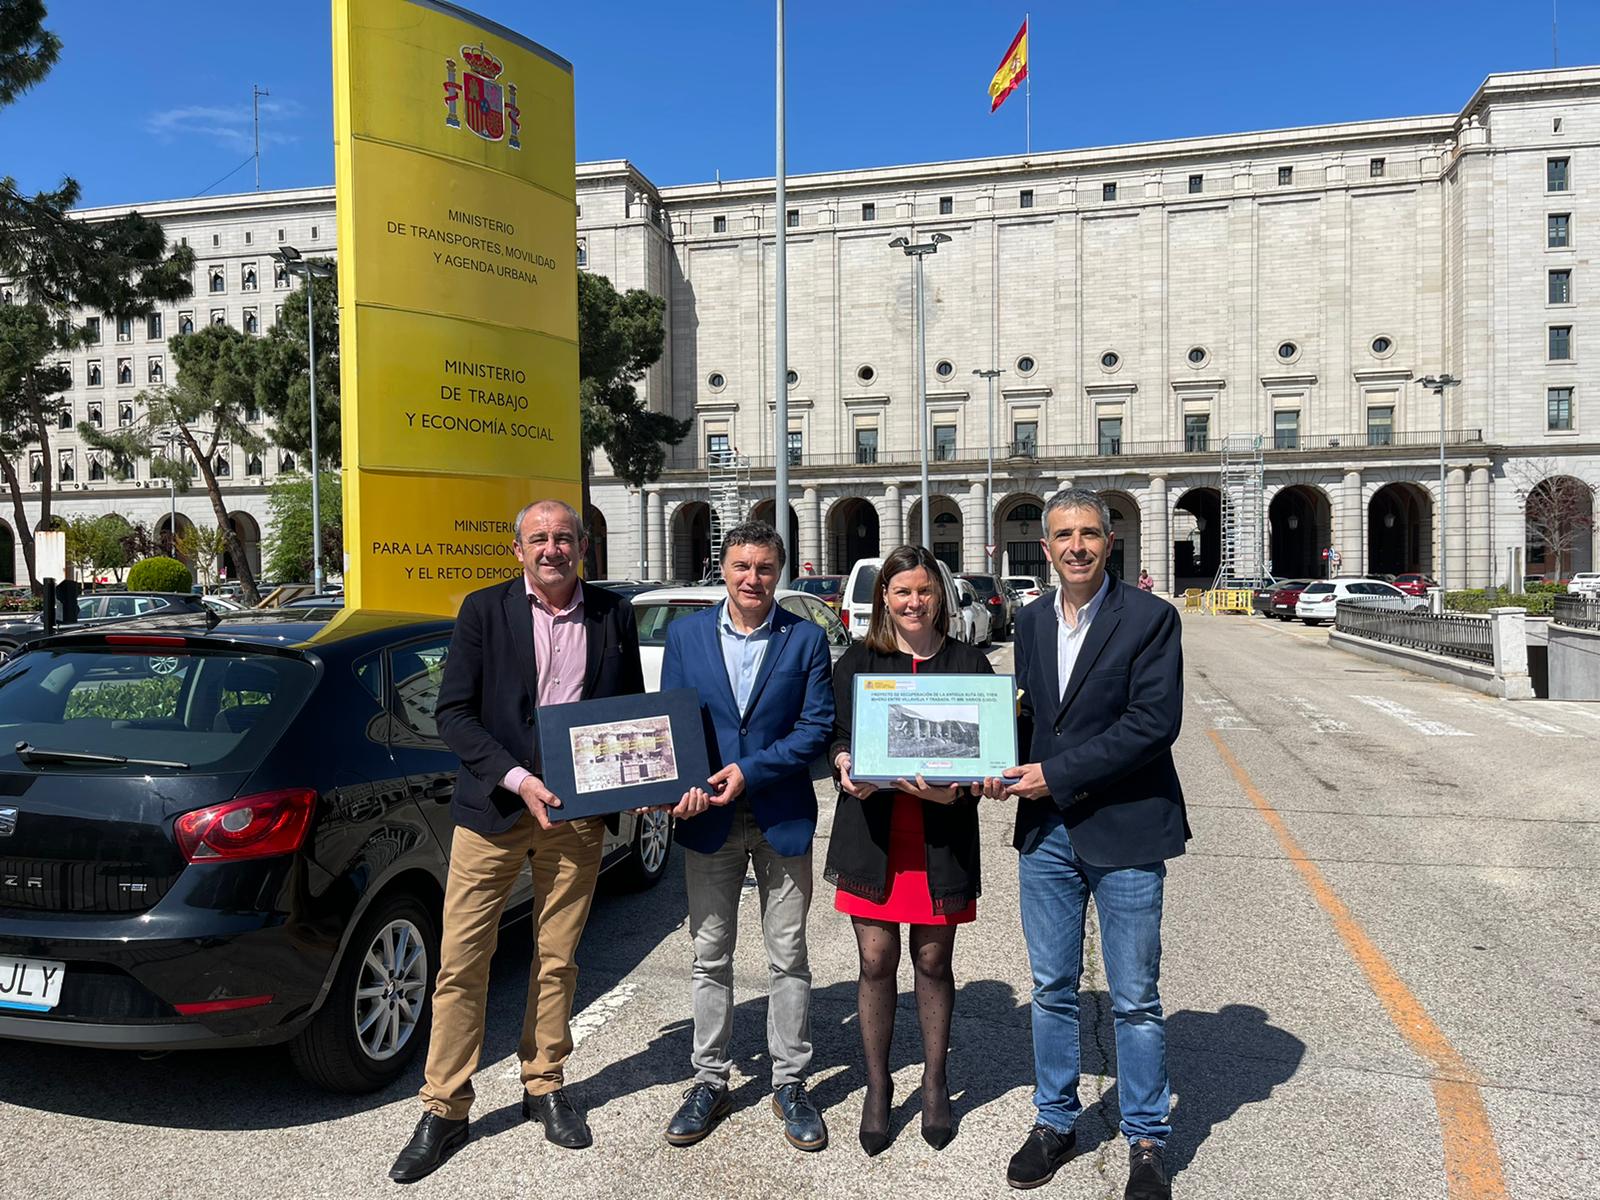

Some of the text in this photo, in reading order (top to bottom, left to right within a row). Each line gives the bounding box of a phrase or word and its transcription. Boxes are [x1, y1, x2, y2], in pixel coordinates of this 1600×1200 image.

[448, 209, 515, 236] MINISTERIO
[387, 221, 556, 270] DE TRANSPORTES, MOVILIDAD
[433, 252, 538, 285] Y AGENDA URBANA
[445, 360, 526, 384] MINISTERIO
[441, 386, 529, 412] DE TRABAJO
[405, 412, 554, 441] Y ECONOMÍA SOCIAL
[372, 542, 515, 556] PARA LA TRANSICIÓN
[405, 567, 414, 579] Y
[419, 568, 433, 579] EL
[438, 567, 473, 579] RETO
[0, 963, 58, 998] JLY
